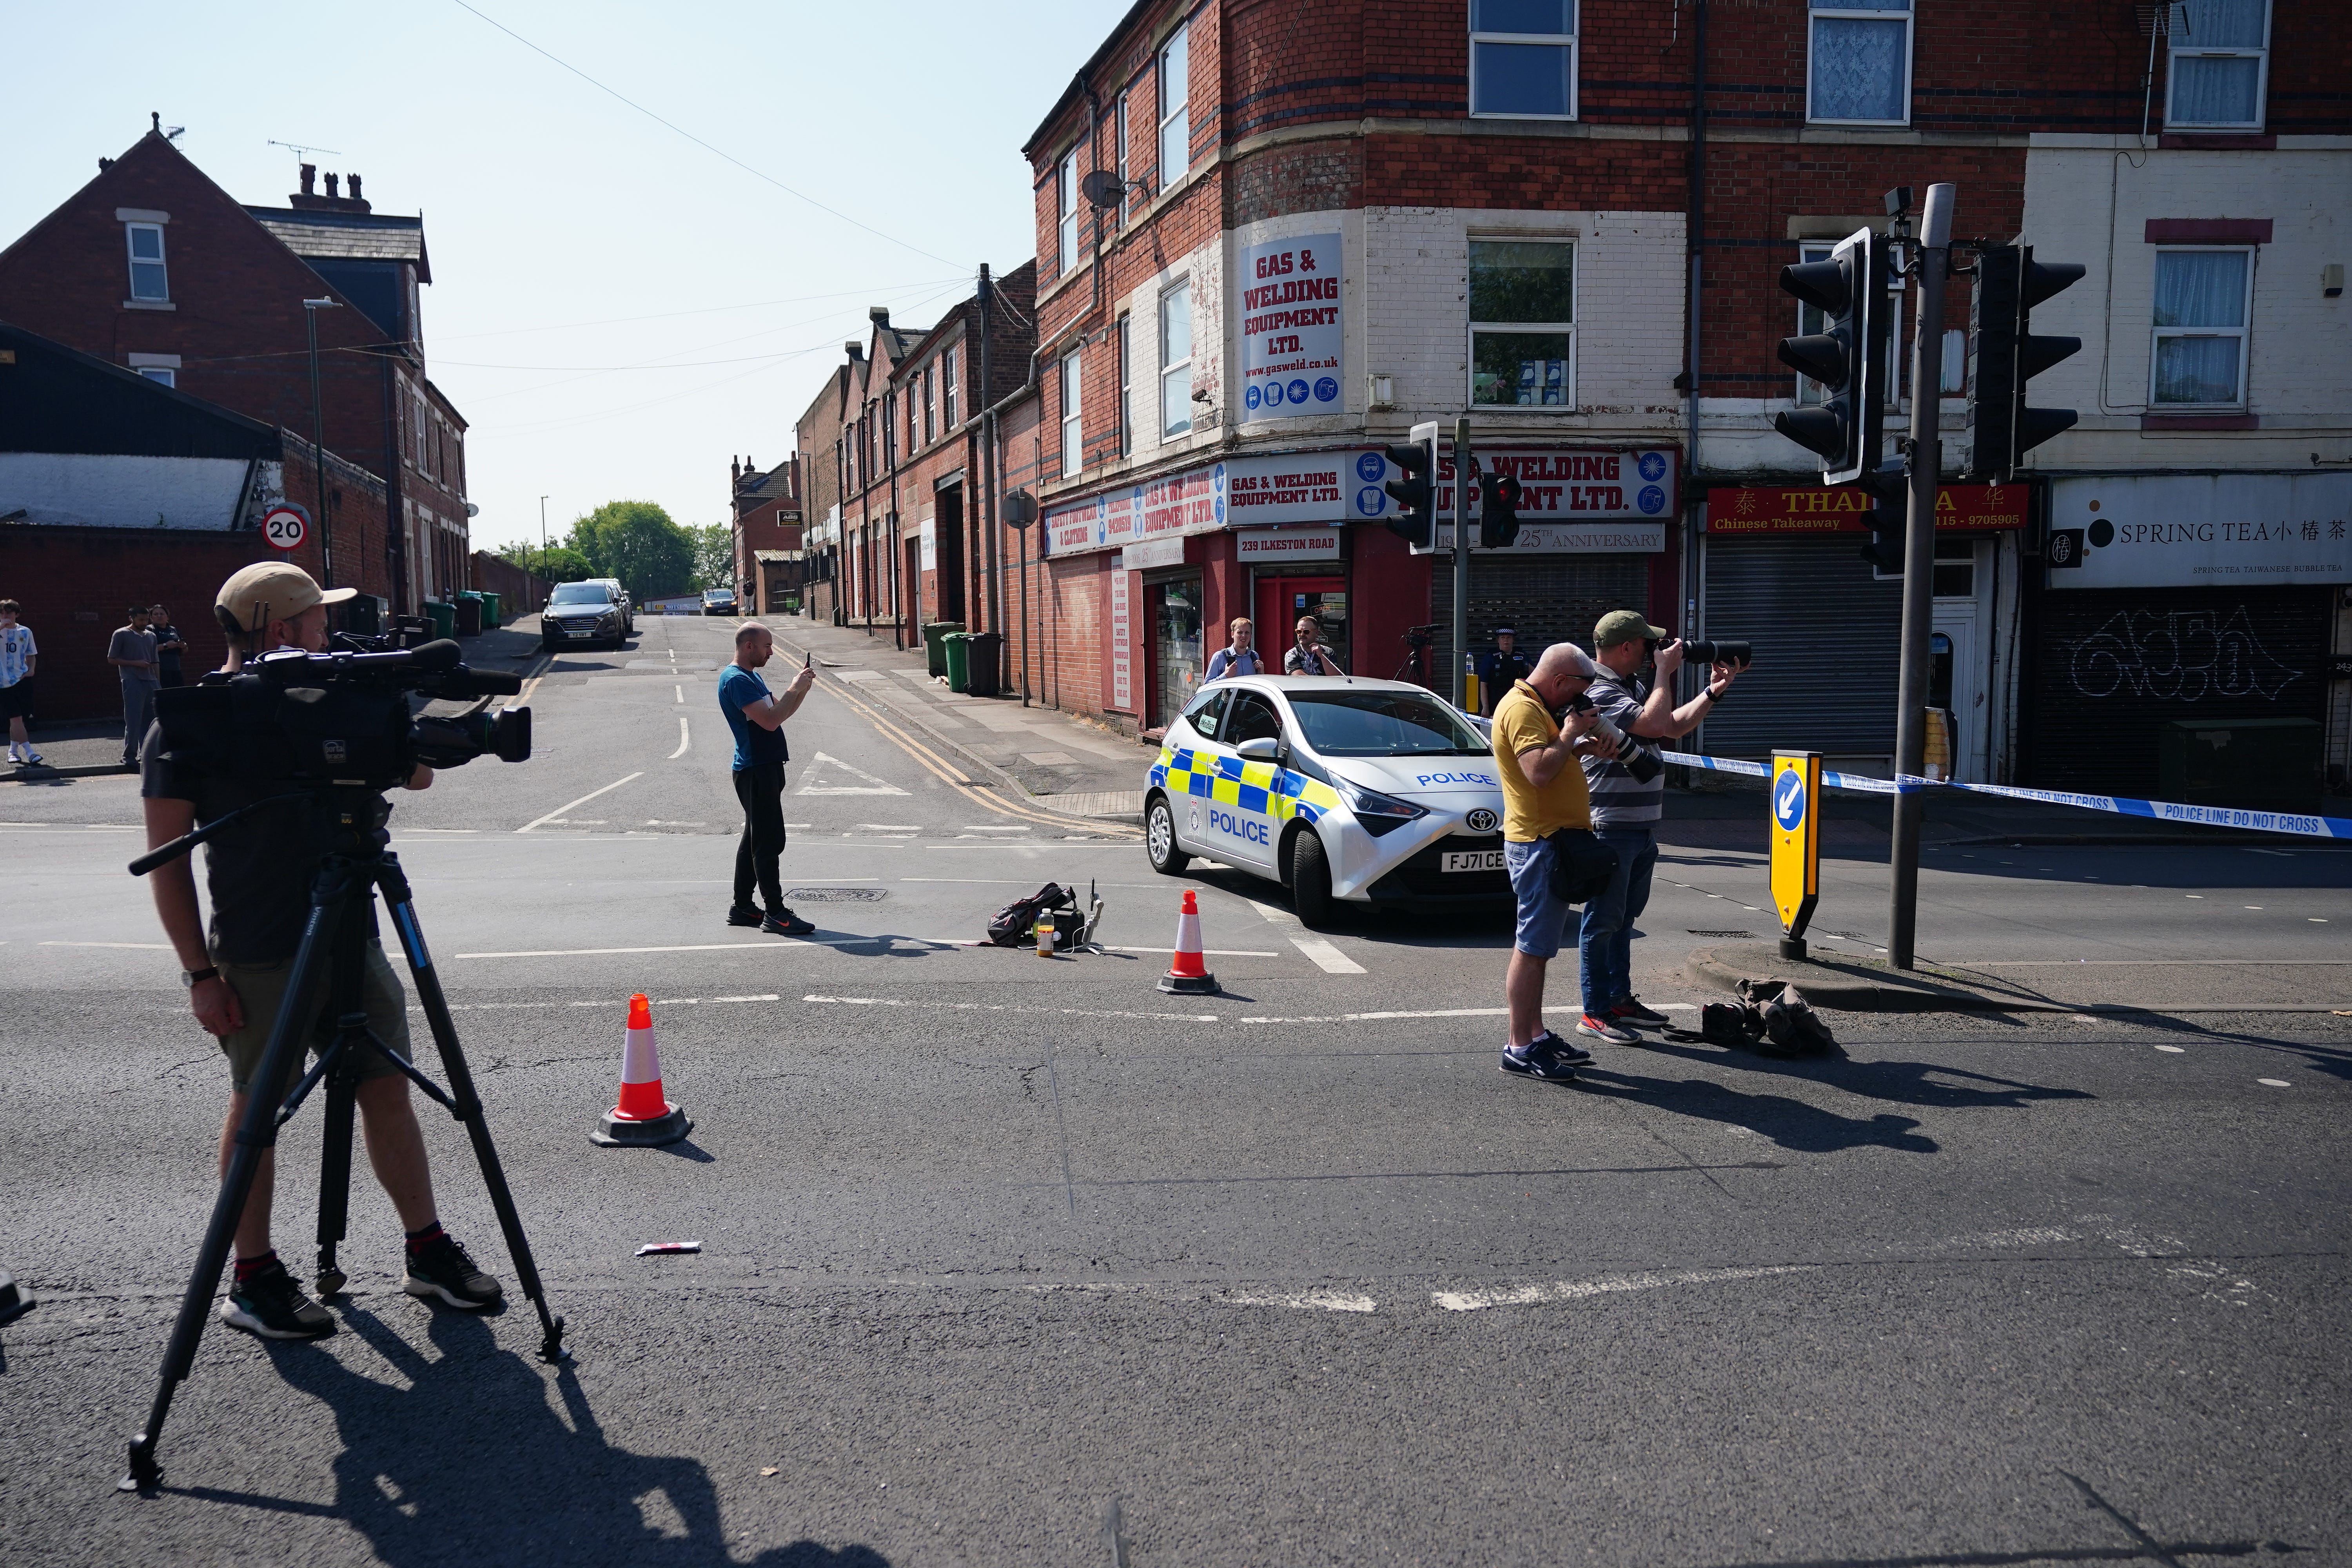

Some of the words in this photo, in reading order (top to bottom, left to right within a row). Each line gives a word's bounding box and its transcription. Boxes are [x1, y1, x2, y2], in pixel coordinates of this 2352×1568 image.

[1256, 252, 1293, 279] GAS
[1300, 249, 1317, 272] &
[1244, 277, 1338, 311] WELDING
[1245, 307, 1338, 336] EQUIPMENT
[1268, 335, 1304, 355] LTD.
[1245, 356, 1338, 378] www.gasweld.co.uk
[1492, 456, 1619, 480] WELDING
[1145, 485, 1158, 507] GAS
[1161, 483, 1167, 504] &
[1168, 470, 1209, 502] WELDING
[1232, 477, 1257, 491] GAS
[1261, 476, 1270, 489] &
[1274, 472, 1337, 488] WELDING
[1108, 498, 1131, 514] TELEPHONE
[1230, 489, 1308, 507] EQUIPMENT
[1312, 488, 1342, 502] LTD.
[1570, 486, 1629, 510] LTD.
[1734, 491, 1756, 515] 泰
[1982, 488, 2004, 511] 华
[1051, 510, 1068, 528] SAFETY
[1070, 503, 1097, 524] FOOTWEAR
[1108, 515, 1131, 534] 9420519
[1145, 503, 1190, 534] EQUIPMENT
[1192, 499, 1213, 523] LTD.
[1715, 518, 1768, 529] Chinese
[1771, 518, 1840, 530] Takeaway
[1935, 516, 1956, 526] 115
[1969, 514, 2019, 525] 9705905
[269, 521, 301, 539] 20
[1060, 532, 1063, 546] &
[1064, 526, 1088, 545] CLOTHING
[1521, 529, 1553, 547] 25TH
[1553, 534, 1661, 546] ANNIVERSARY
[2120, 523, 2214, 545] SPRING
[2222, 523, 2269, 541] TEA
[2272, 520, 2347, 541] 小椿茶
[1151, 547, 1181, 561] ANNIVERSARY
[1242, 541, 1258, 551] 239
[1261, 539, 1306, 551] ILKESTON
[1309, 538, 1334, 549] ROAD
[2054, 537, 2069, 560] 椿
[1314, 605, 1330, 613] OPEN
[5, 642, 16, 653] 10
[2336, 662, 2352, 672] 243
[1716, 759, 1728, 770] POLICE
[1737, 762, 1741, 771] DO
[1749, 764, 1760, 774] CROSS
[1417, 772, 1497, 786] POLICE
[1844, 775, 1857, 786] POLICE
[2054, 793, 2072, 804] NOT
[2076, 795, 2109, 810] CROSS
[1210, 809, 1269, 846] POLICE
[2165, 805, 2203, 820] POLICE
[2206, 809, 2230, 823] LINE
[2234, 812, 2249, 826] DO
[2253, 814, 2276, 829] NOT
[2279, 816, 2319, 833] CROSS
[1450, 854, 1482, 869] FJ71
[1486, 852, 1504, 867] CE
[307, 907, 321, 935] Vinten
